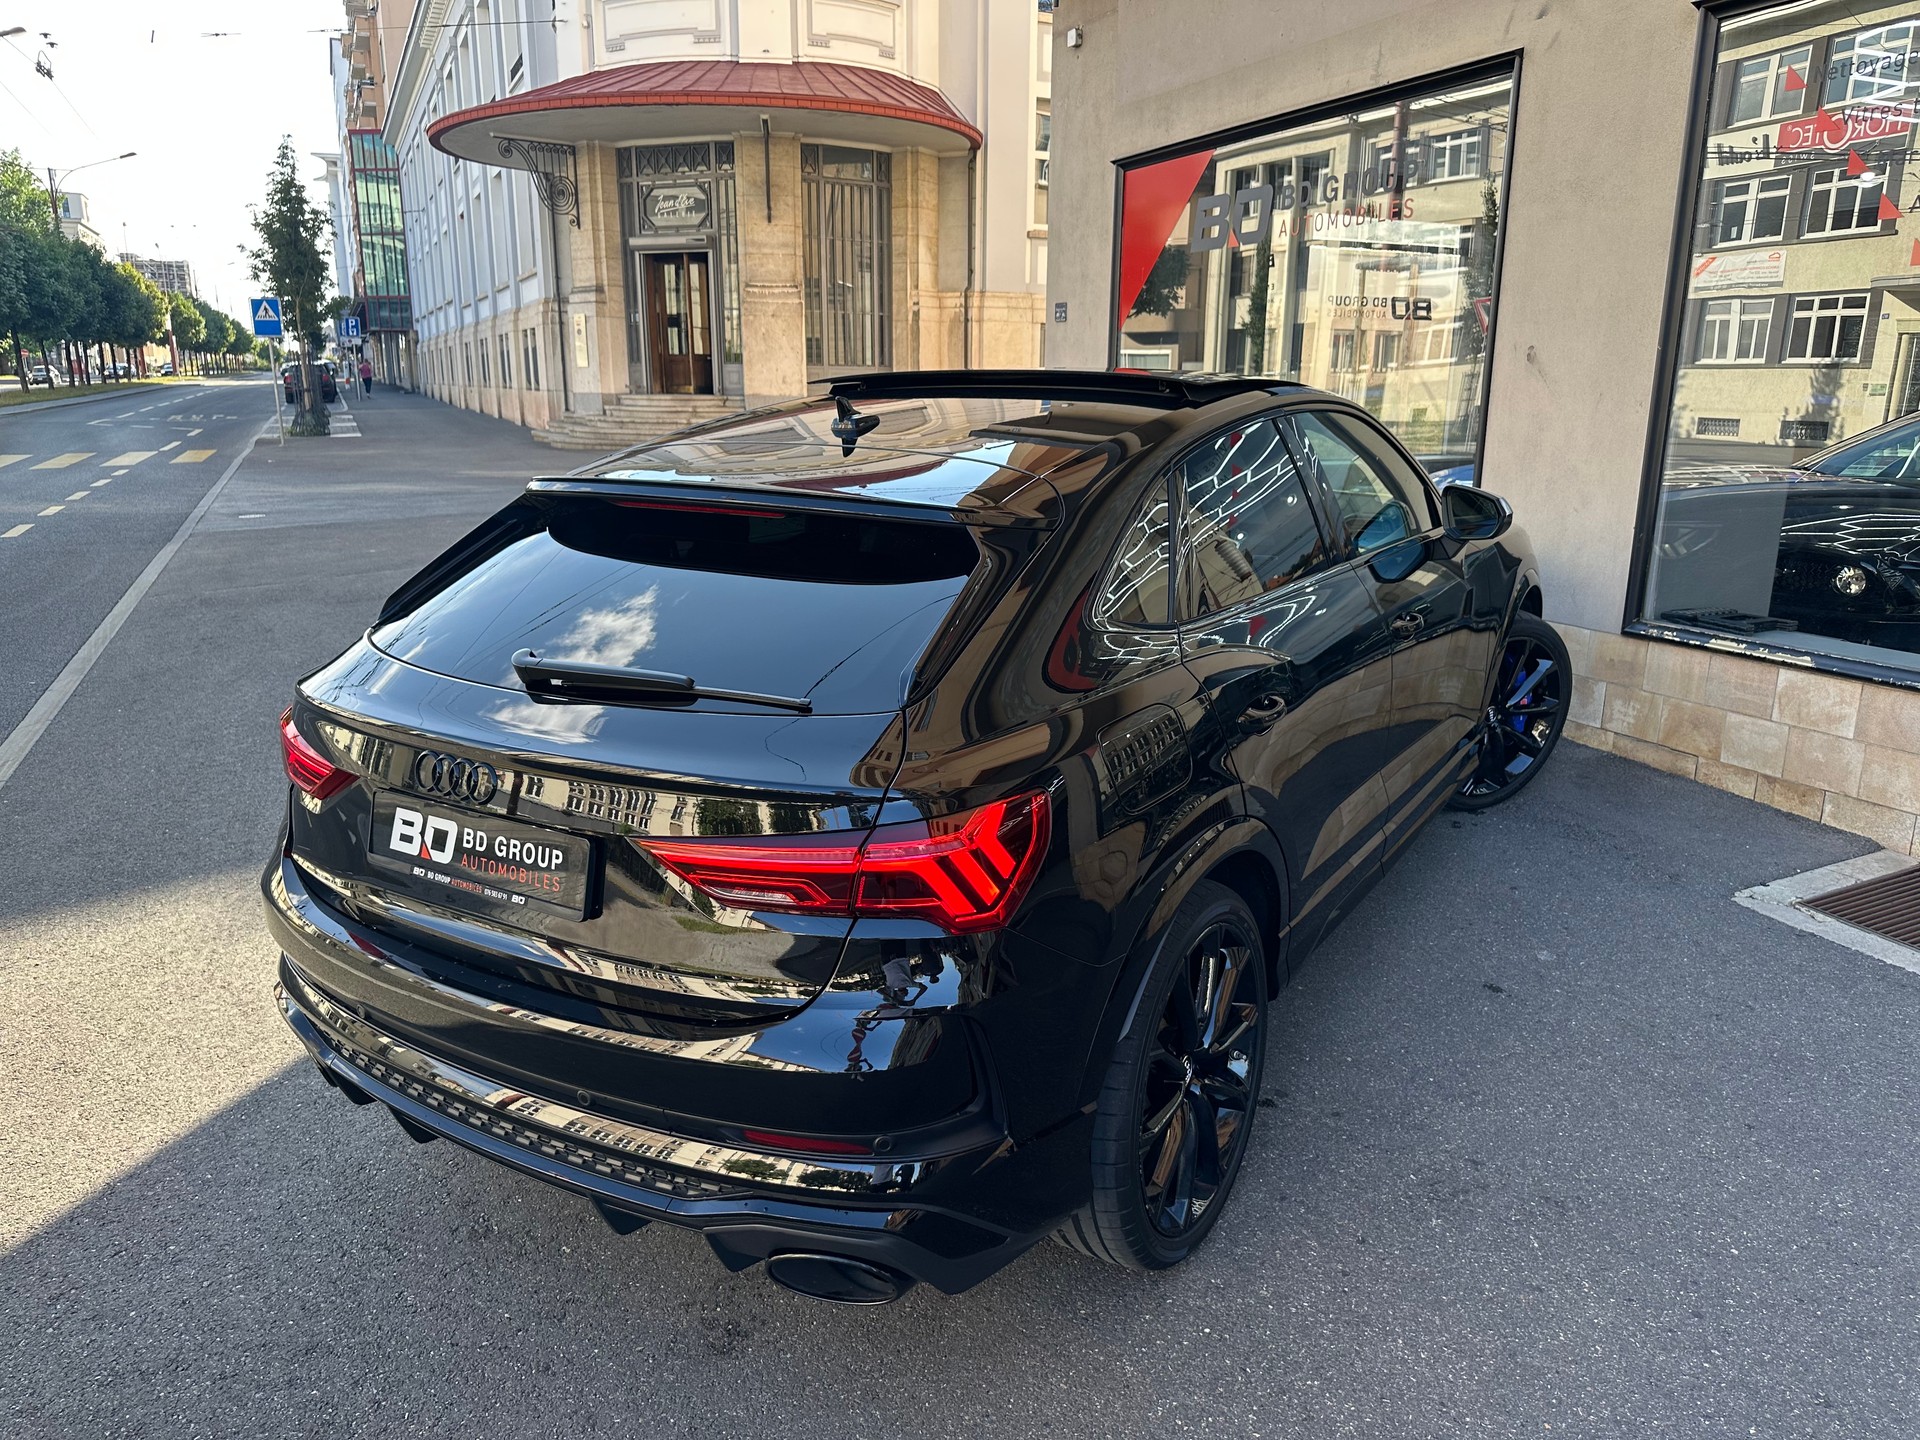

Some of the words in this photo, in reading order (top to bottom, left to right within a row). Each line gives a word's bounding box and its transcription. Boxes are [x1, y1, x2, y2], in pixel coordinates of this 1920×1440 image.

[1814, 50, 1919, 83] Nettoyage
[1842, 103, 1903, 125] Vitres
[1281, 180, 1312, 210] BD
[1322, 159, 1419, 204] GROUP
[1278, 198, 1415, 239] AUTOMOBILES
[462, 827, 488, 852] BD
[494, 835, 563, 870] GROUP
[434, 872, 451, 884] GROUP
[451, 878, 482, 893] AUTOMOBILES
[461, 853, 561, 892] AUTOMOBILES
